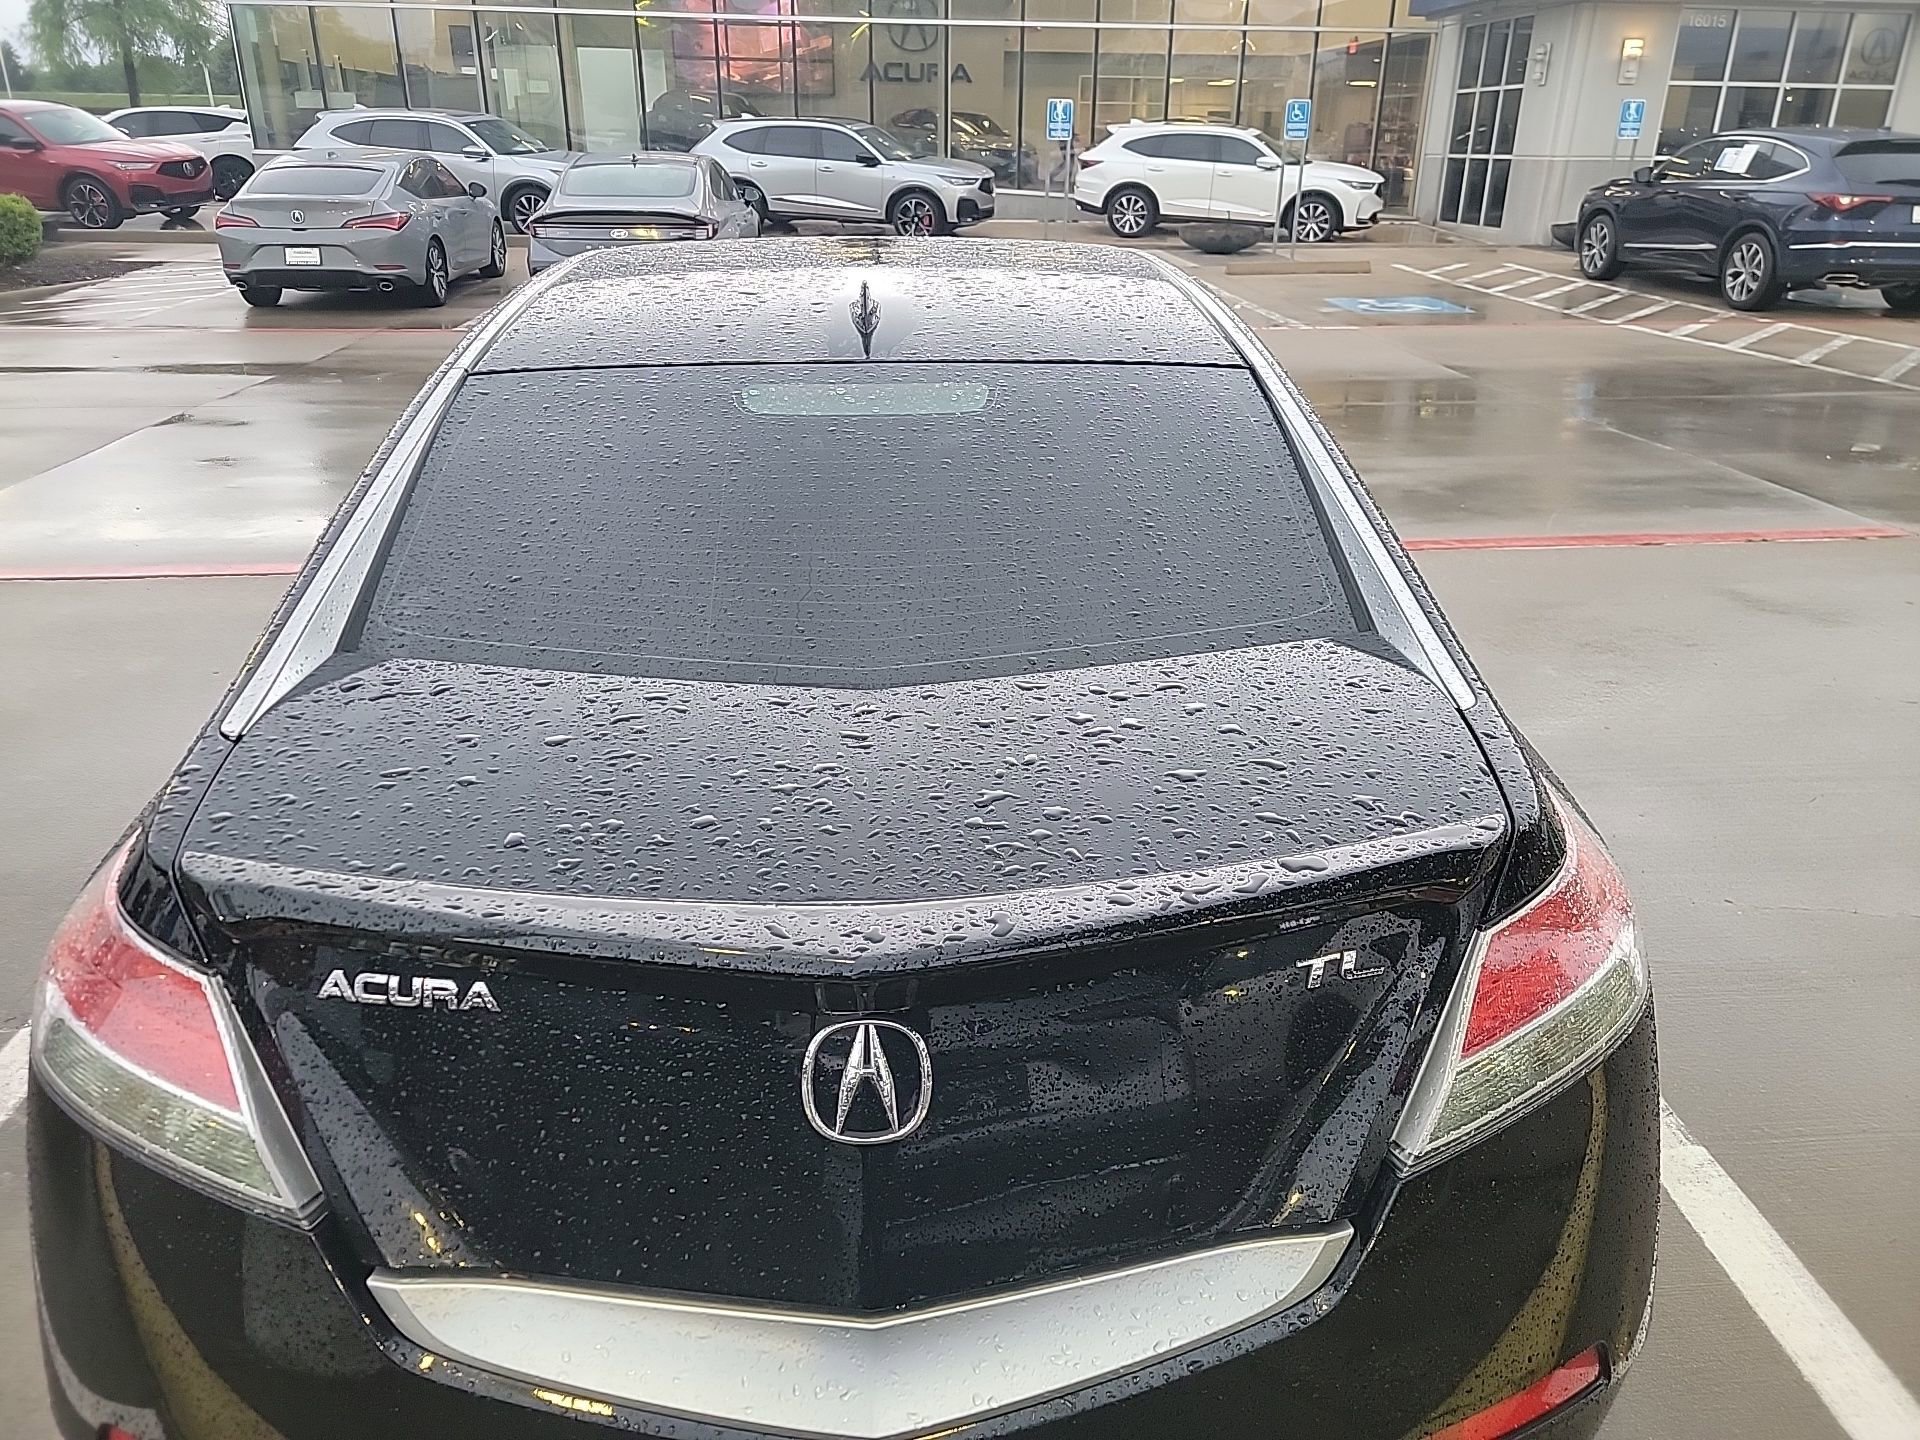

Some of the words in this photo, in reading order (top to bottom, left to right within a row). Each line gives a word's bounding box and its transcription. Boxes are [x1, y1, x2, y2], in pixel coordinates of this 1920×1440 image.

[1689, 14, 1727, 28] 16015
[859, 61, 972, 83] ACURA
[1295, 949, 1386, 989] TL
[316, 969, 502, 1013] ACURA
